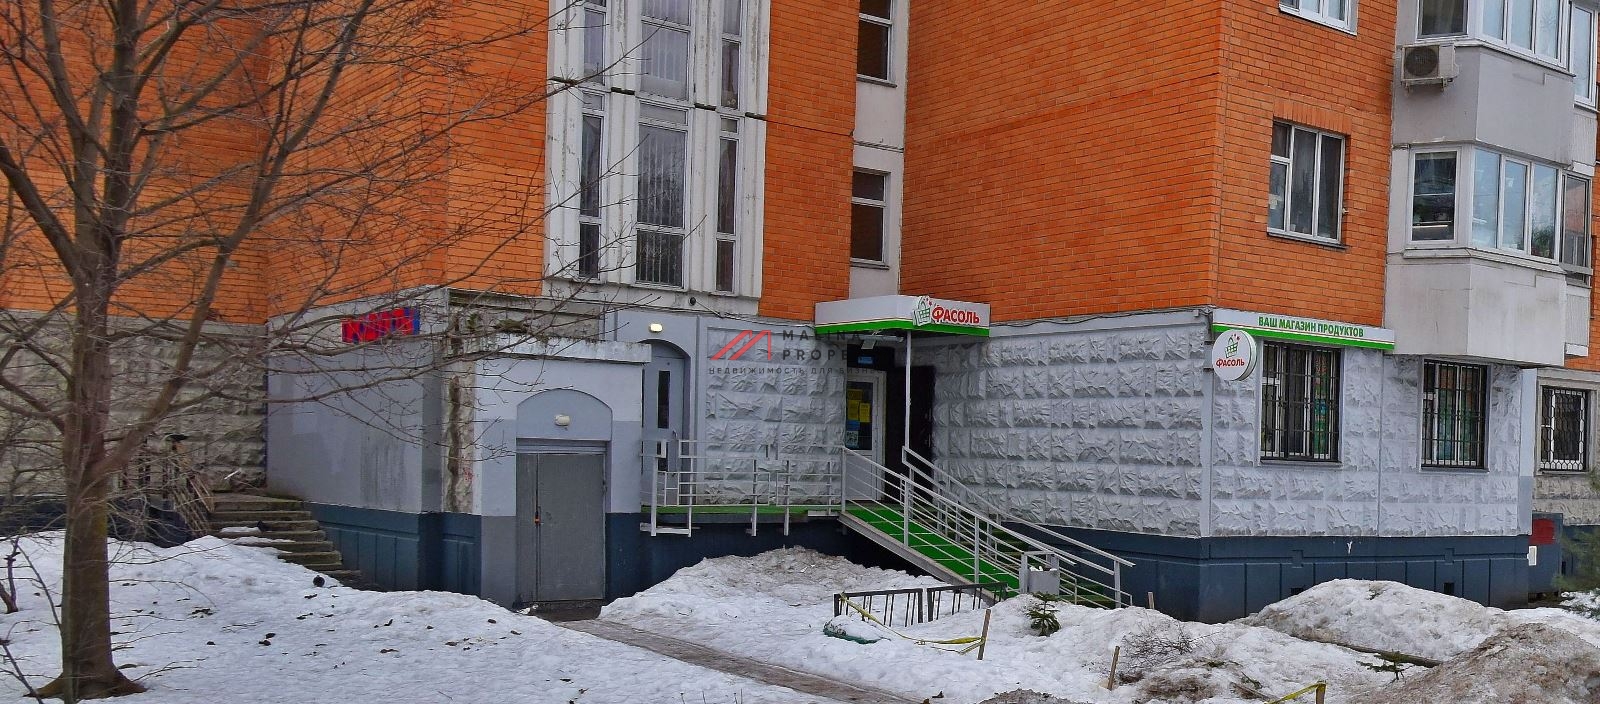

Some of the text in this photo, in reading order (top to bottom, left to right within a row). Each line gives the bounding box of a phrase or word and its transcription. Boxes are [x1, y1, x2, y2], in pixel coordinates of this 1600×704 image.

[932, 306, 980, 324] ФАСОЛЬ
[1258, 316, 1364, 338] ВАШ МАГАЗИН ПРОДУКТОВ
[1216, 358, 1245, 368] ФАСОЛЬ
